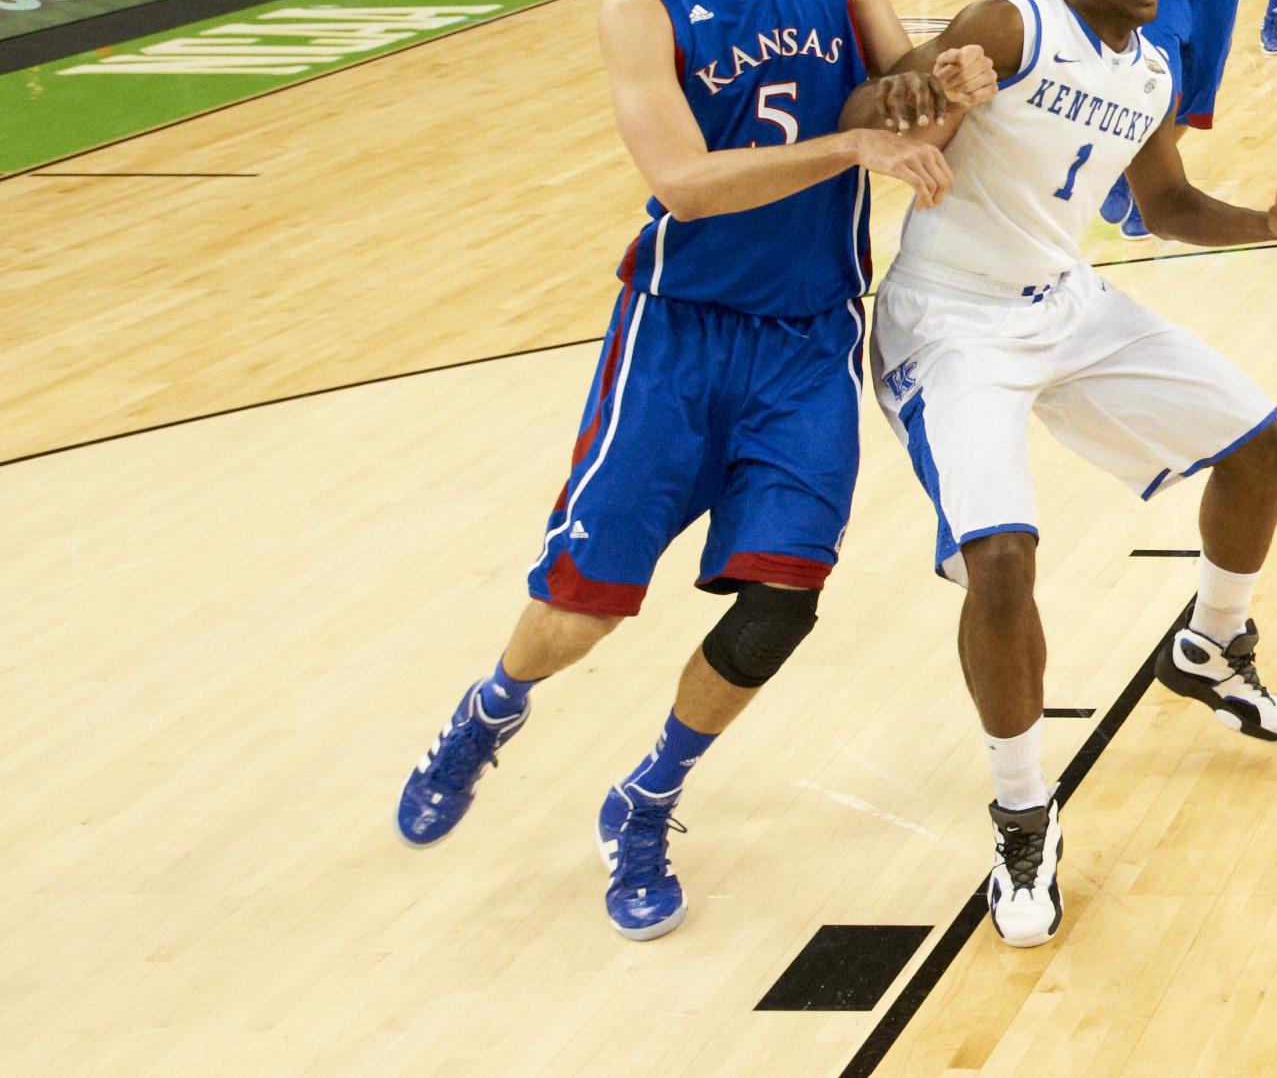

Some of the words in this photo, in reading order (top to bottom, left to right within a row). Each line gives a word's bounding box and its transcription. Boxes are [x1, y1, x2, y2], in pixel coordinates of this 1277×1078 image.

[55, 2, 503, 77] NCAA
[694, 27, 844, 96] KANSAS
[756, 80, 800, 146] 5
[1026, 78, 1154, 144] KENTUCKY
[1053, 143, 1094, 202] 1
